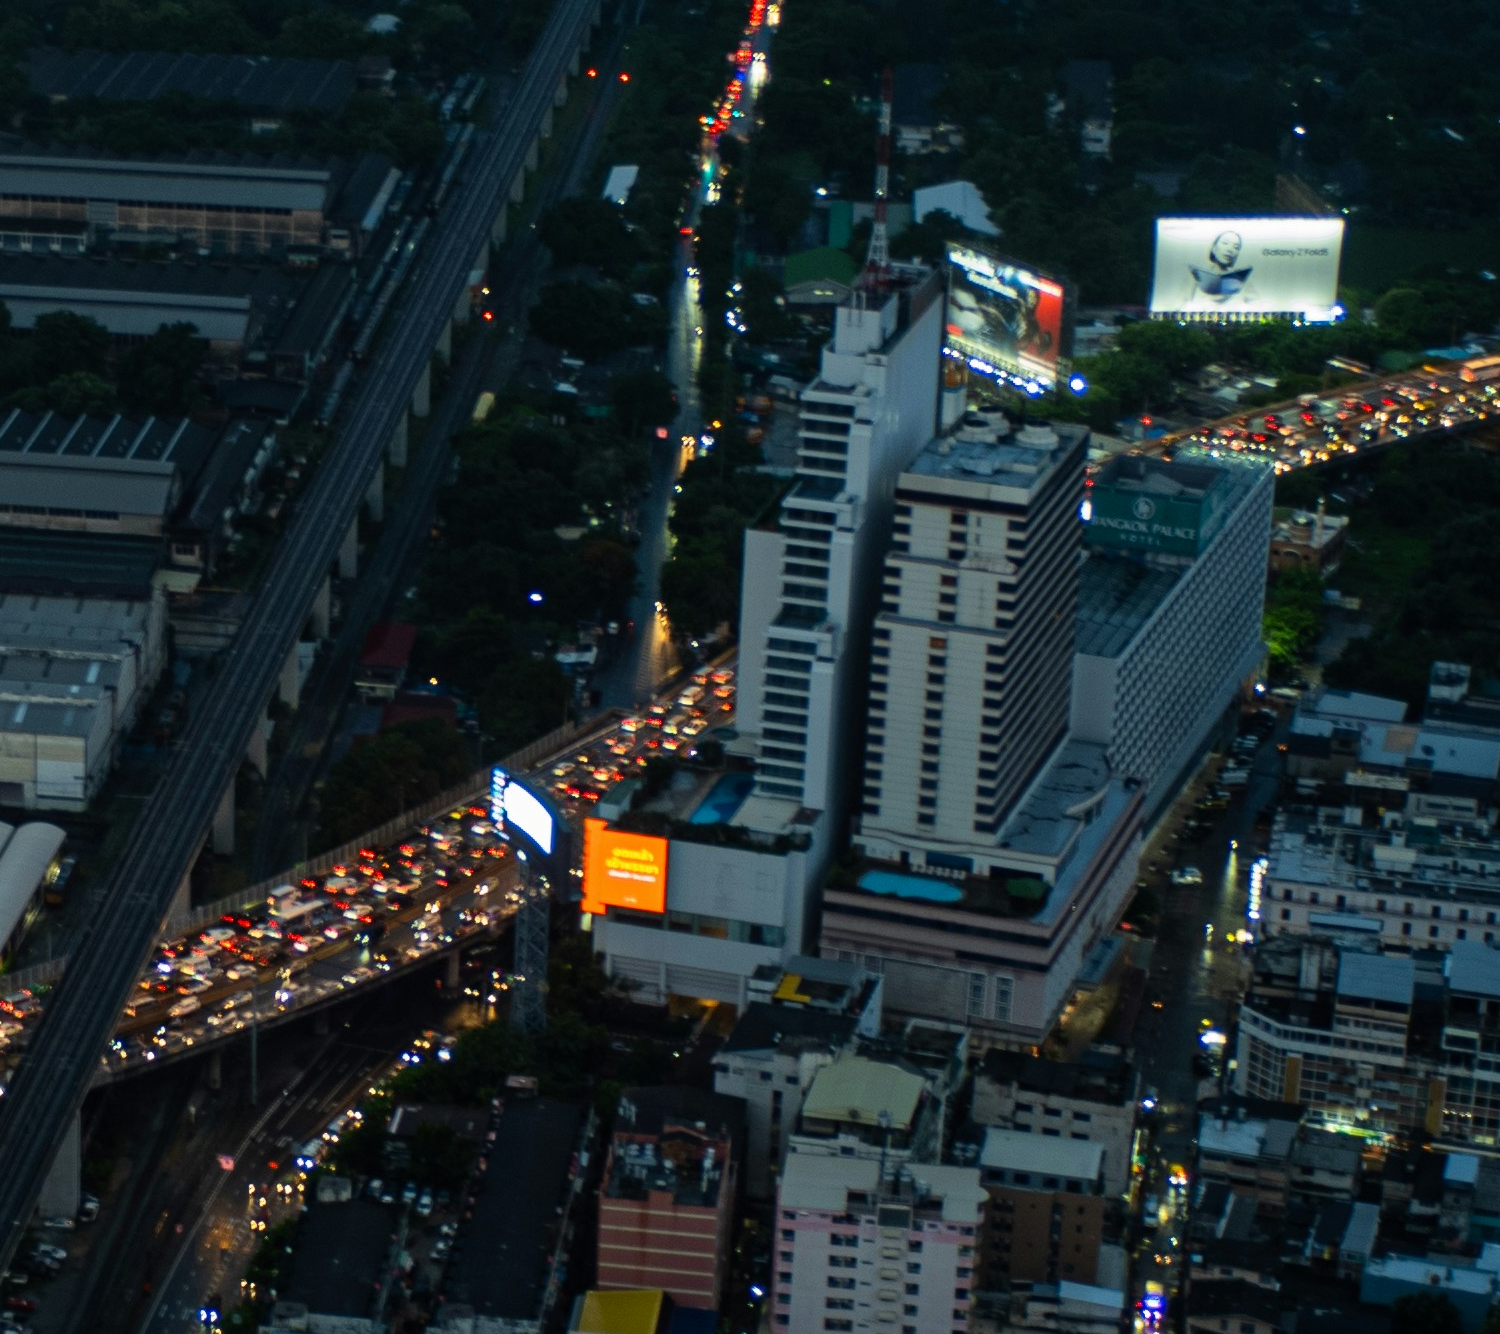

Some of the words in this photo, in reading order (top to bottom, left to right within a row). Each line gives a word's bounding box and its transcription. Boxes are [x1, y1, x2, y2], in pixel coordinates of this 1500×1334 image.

[1262, 248, 1295, 258] Galaxy
[1119, 532, 1162, 546] HOTEL
[1151, 523, 1197, 541] PALACE
